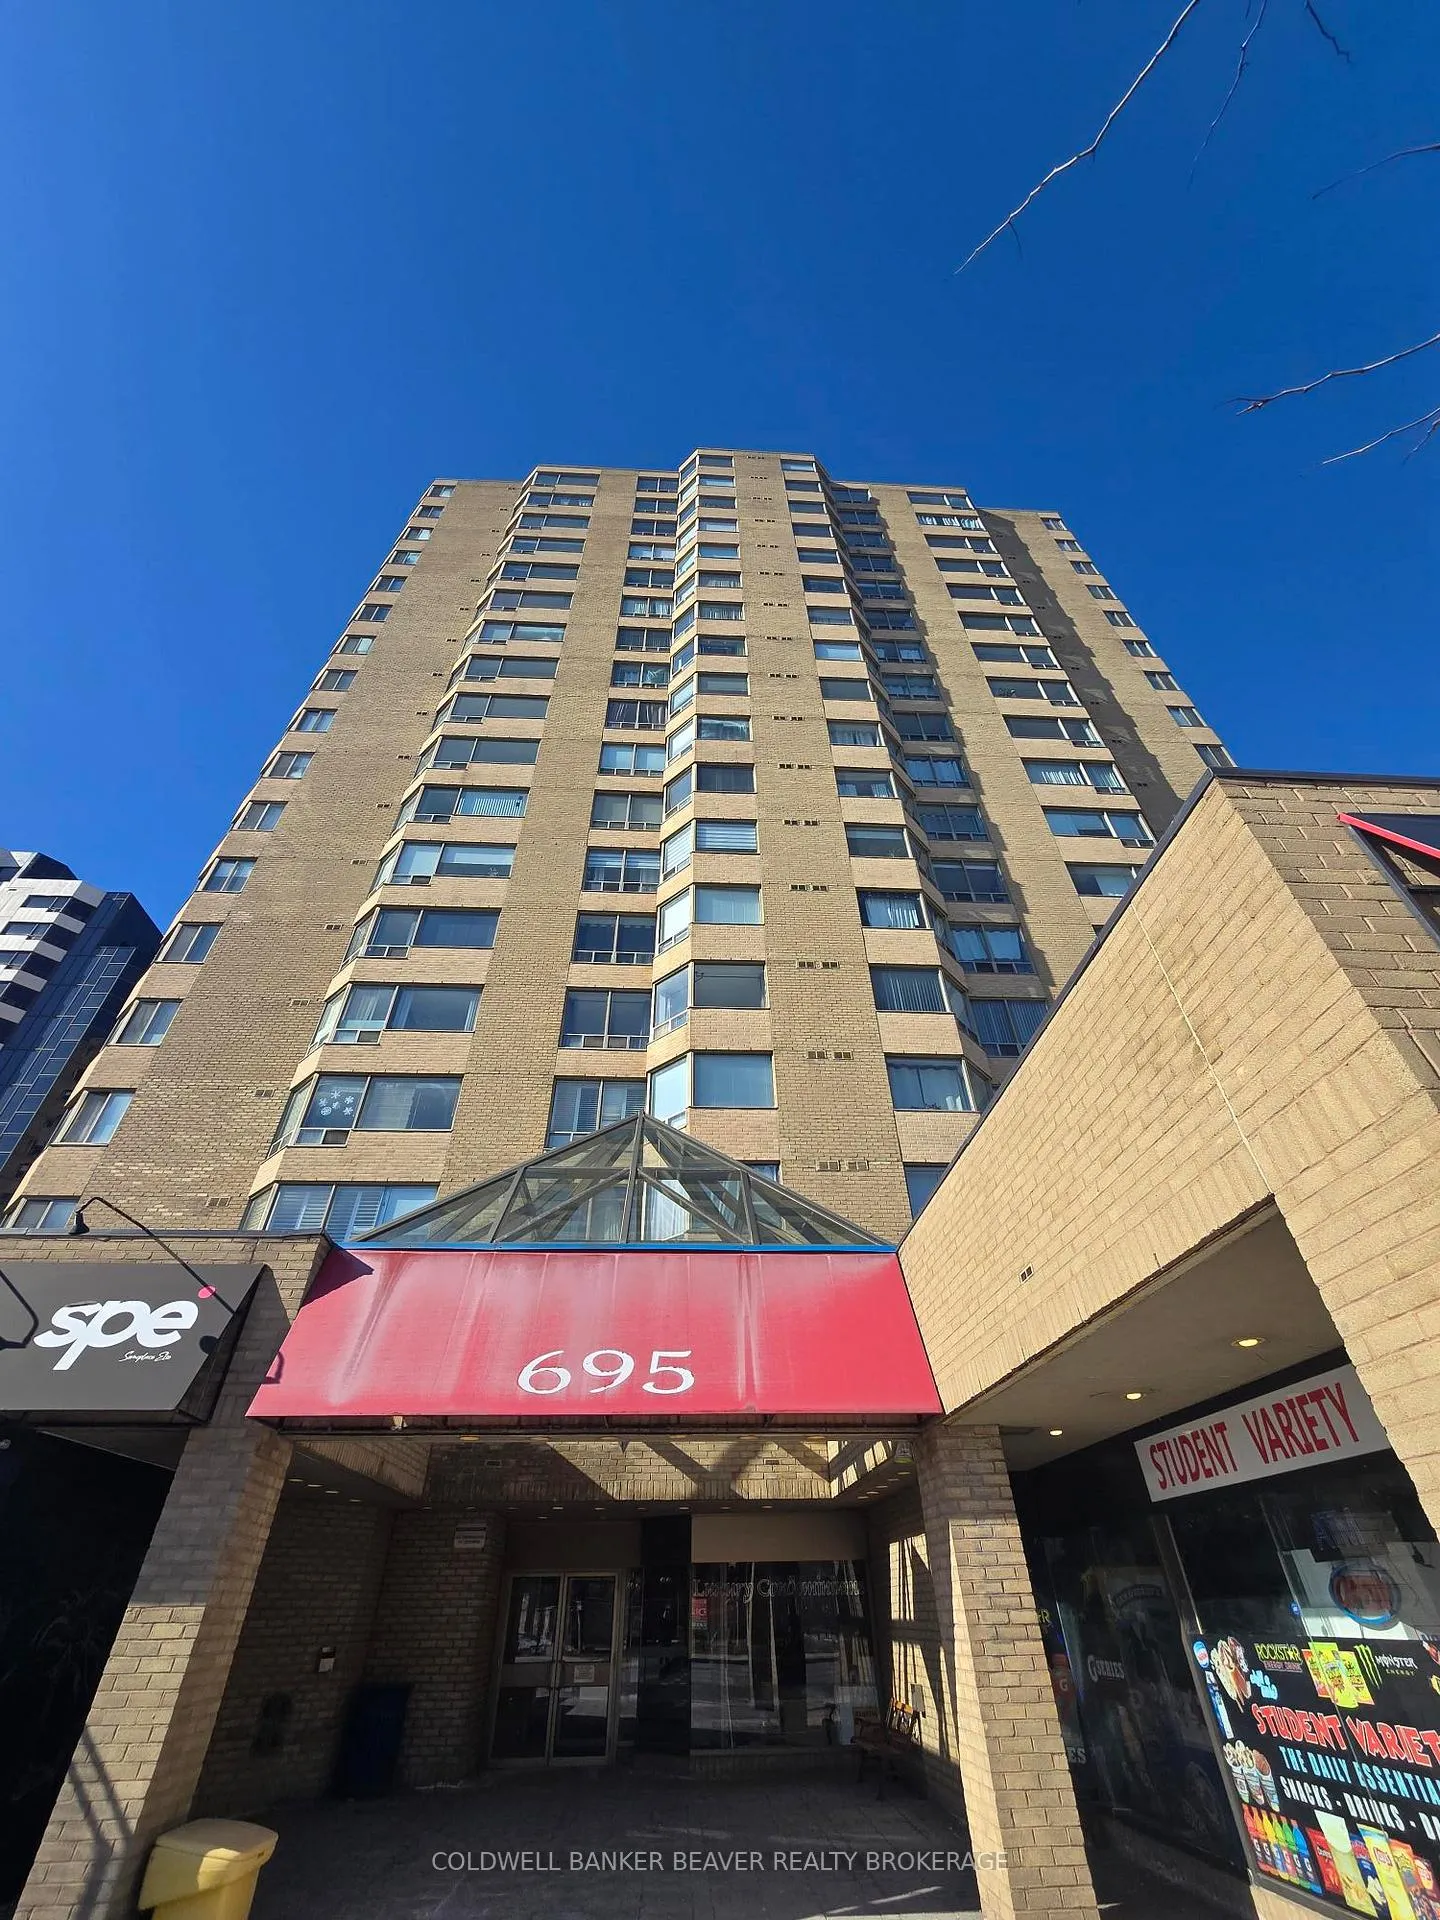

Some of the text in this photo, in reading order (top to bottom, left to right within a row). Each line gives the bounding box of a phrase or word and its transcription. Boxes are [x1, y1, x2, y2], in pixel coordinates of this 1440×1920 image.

[34, 1301, 199, 1370] spe
[518, 1350, 695, 1394] 695
[1149, 1382, 1361, 1490] STUDENT VARIETY
[1252, 1703, 1440, 1768] STUDENT VARIET
[1279, 1746, 1440, 1806] THE DAILY ESSENTIA
[1280, 1776, 1333, 1811] SNACKS
[1343, 1792, 1405, 1832] DRINKS
